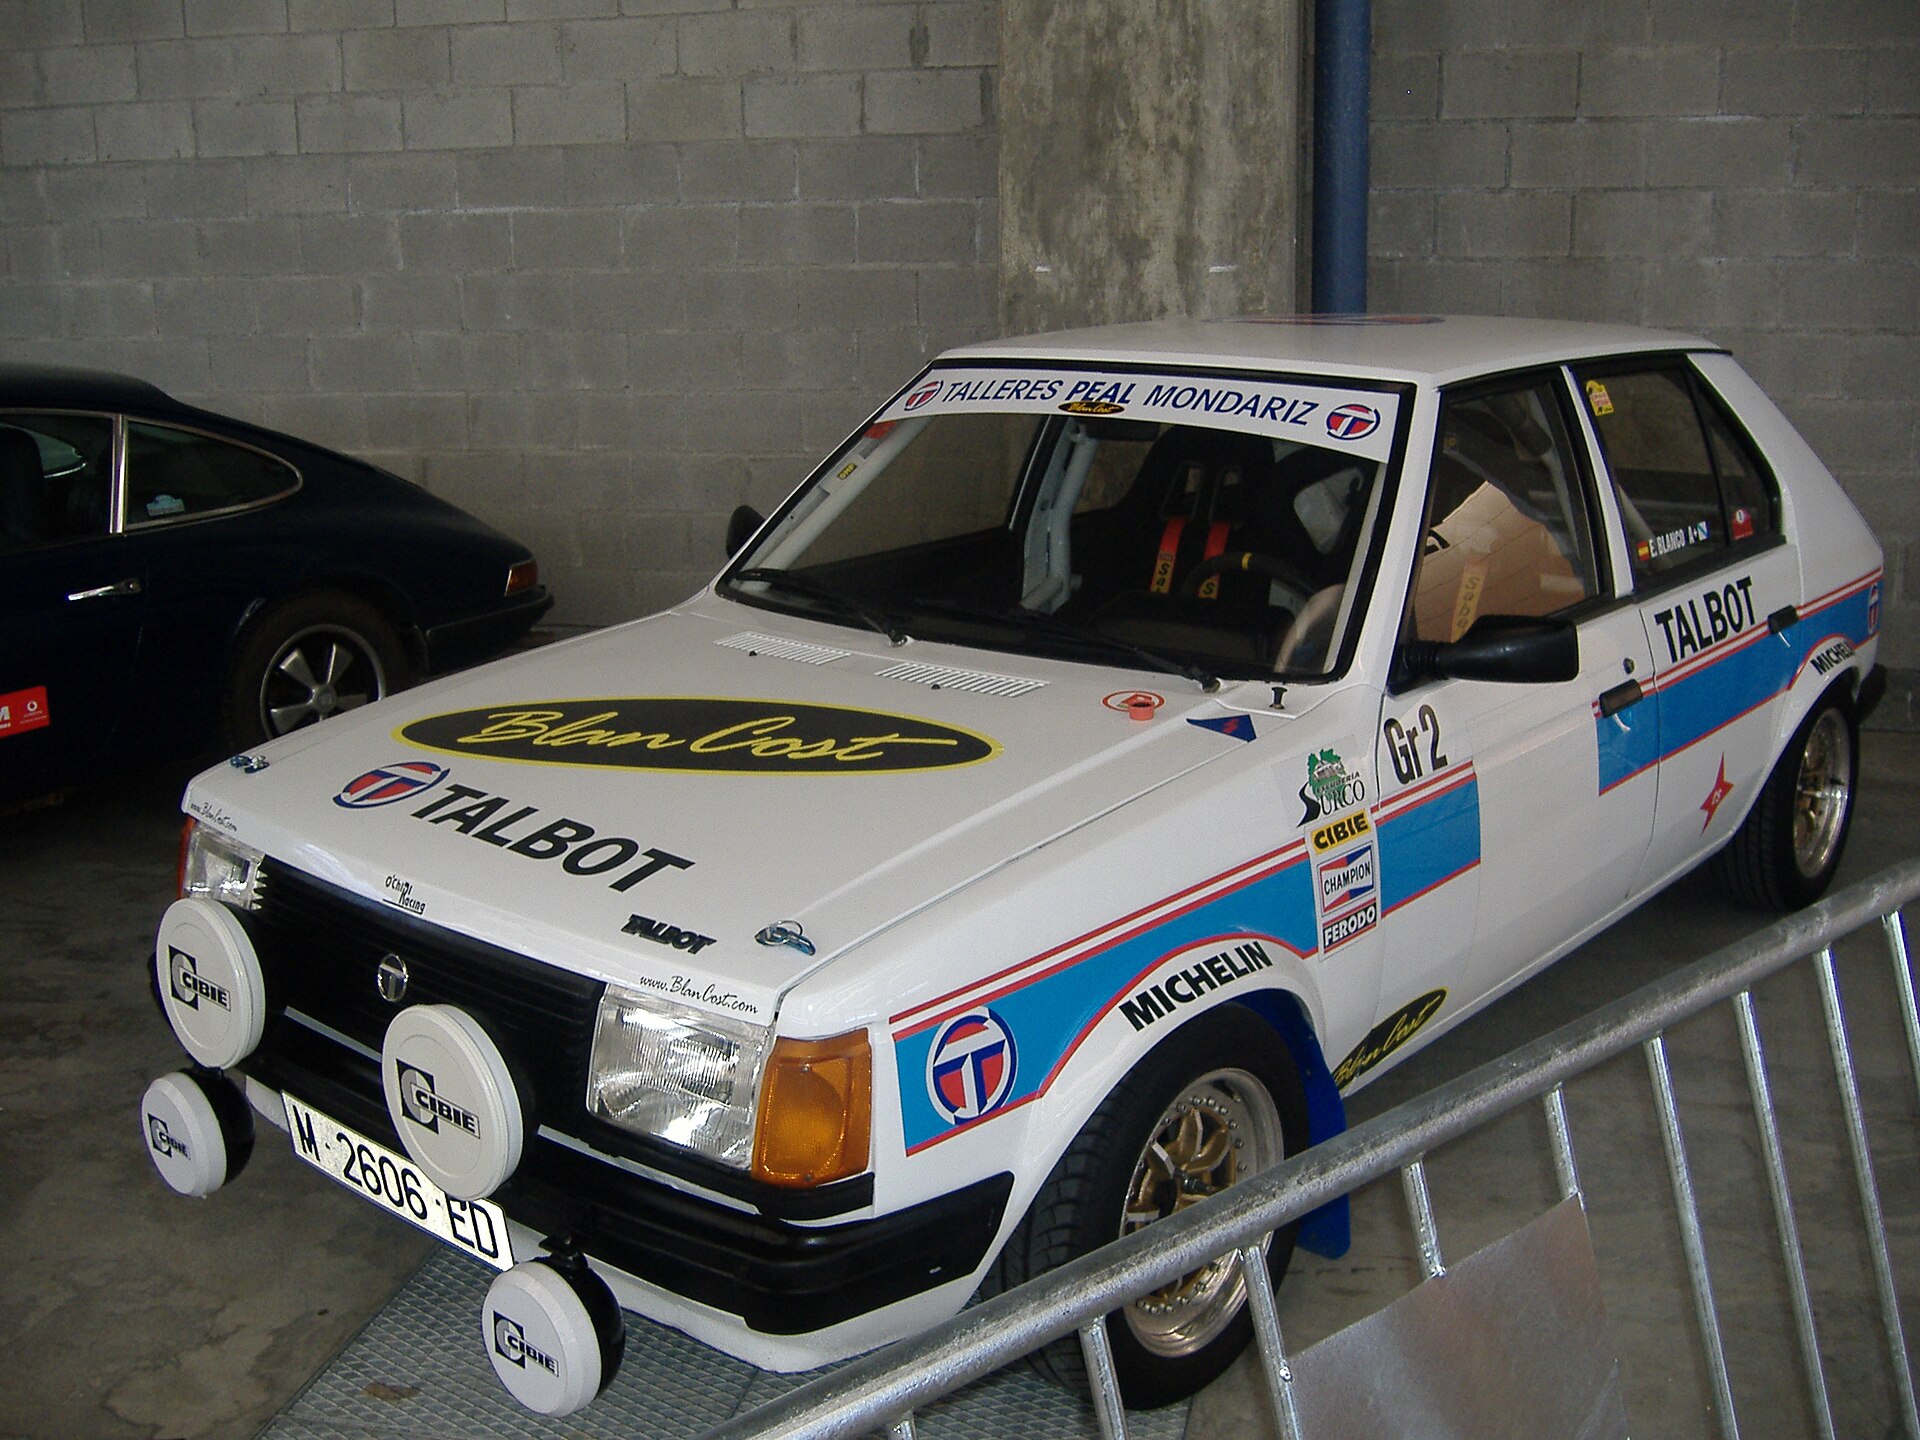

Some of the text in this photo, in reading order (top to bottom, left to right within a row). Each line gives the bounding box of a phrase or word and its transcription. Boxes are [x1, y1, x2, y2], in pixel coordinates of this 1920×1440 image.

[942, 379, 1320, 426] TALLERES PEAL MONDARIZ
[1654, 576, 1757, 664] TALBOT
[456, 710, 958, 762] Blan Cost
[411, 783, 696, 893] TALBOT
[1313, 812, 1369, 850] CIBIE
[1322, 860, 1371, 896] CHAMPION
[1323, 904, 1376, 946] FERODO
[182, 969, 229, 1007] CIBIE
[639, 975, 759, 1014] www.BlanCost.com
[1118, 941, 1273, 1032] MICHELIN
[414, 1088, 477, 1134] CIBIE
[506, 1334, 556, 1374] CIBIE
